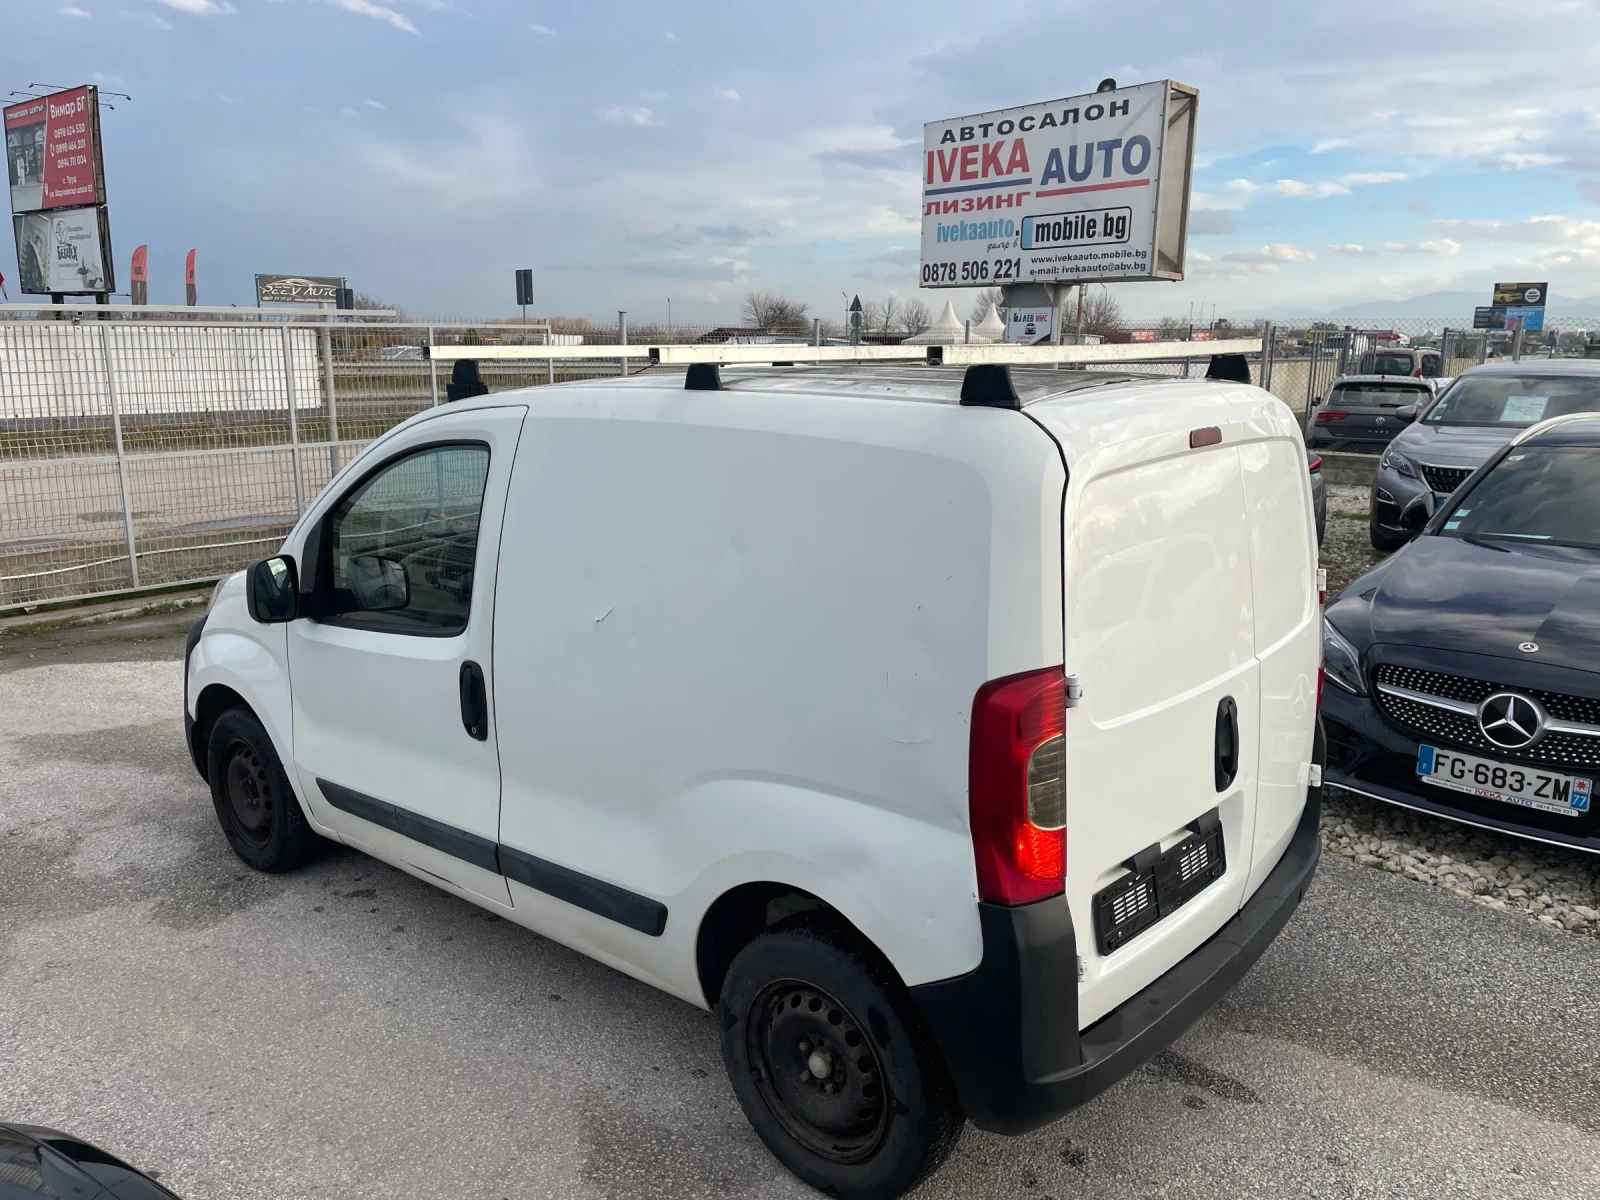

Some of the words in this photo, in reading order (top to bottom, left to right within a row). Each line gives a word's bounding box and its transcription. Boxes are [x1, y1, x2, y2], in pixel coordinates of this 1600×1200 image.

[50, 102, 75, 118] Вимар
[76, 95, 85, 111] БГ
[940, 99, 1130, 144] АВТОСАЛОН
[926, 137, 1030, 185] IVEKA
[1040, 135, 1151, 186] AUTO
[924, 191, 1031, 216] ЛИЗИНГ
[1035, 212, 1127, 242] mobile.bg
[1029, 266, 1059, 276] e-mail:
[1062, 261, 1146, 274] ivekaauto@abv.bg
[1031, 249, 1147, 264] www.ivekaauto.mobile.bg
[922, 262, 957, 282] 0878
[961, 260, 989, 280] 506
[993, 258, 1021, 279] 221
[1434, 753, 1571, 802] FG-683-ZM
[1474, 789, 1503, 799] IVEKA
[1506, 796, 1533, 806] AUTO
[1572, 794, 1587, 807] 77
